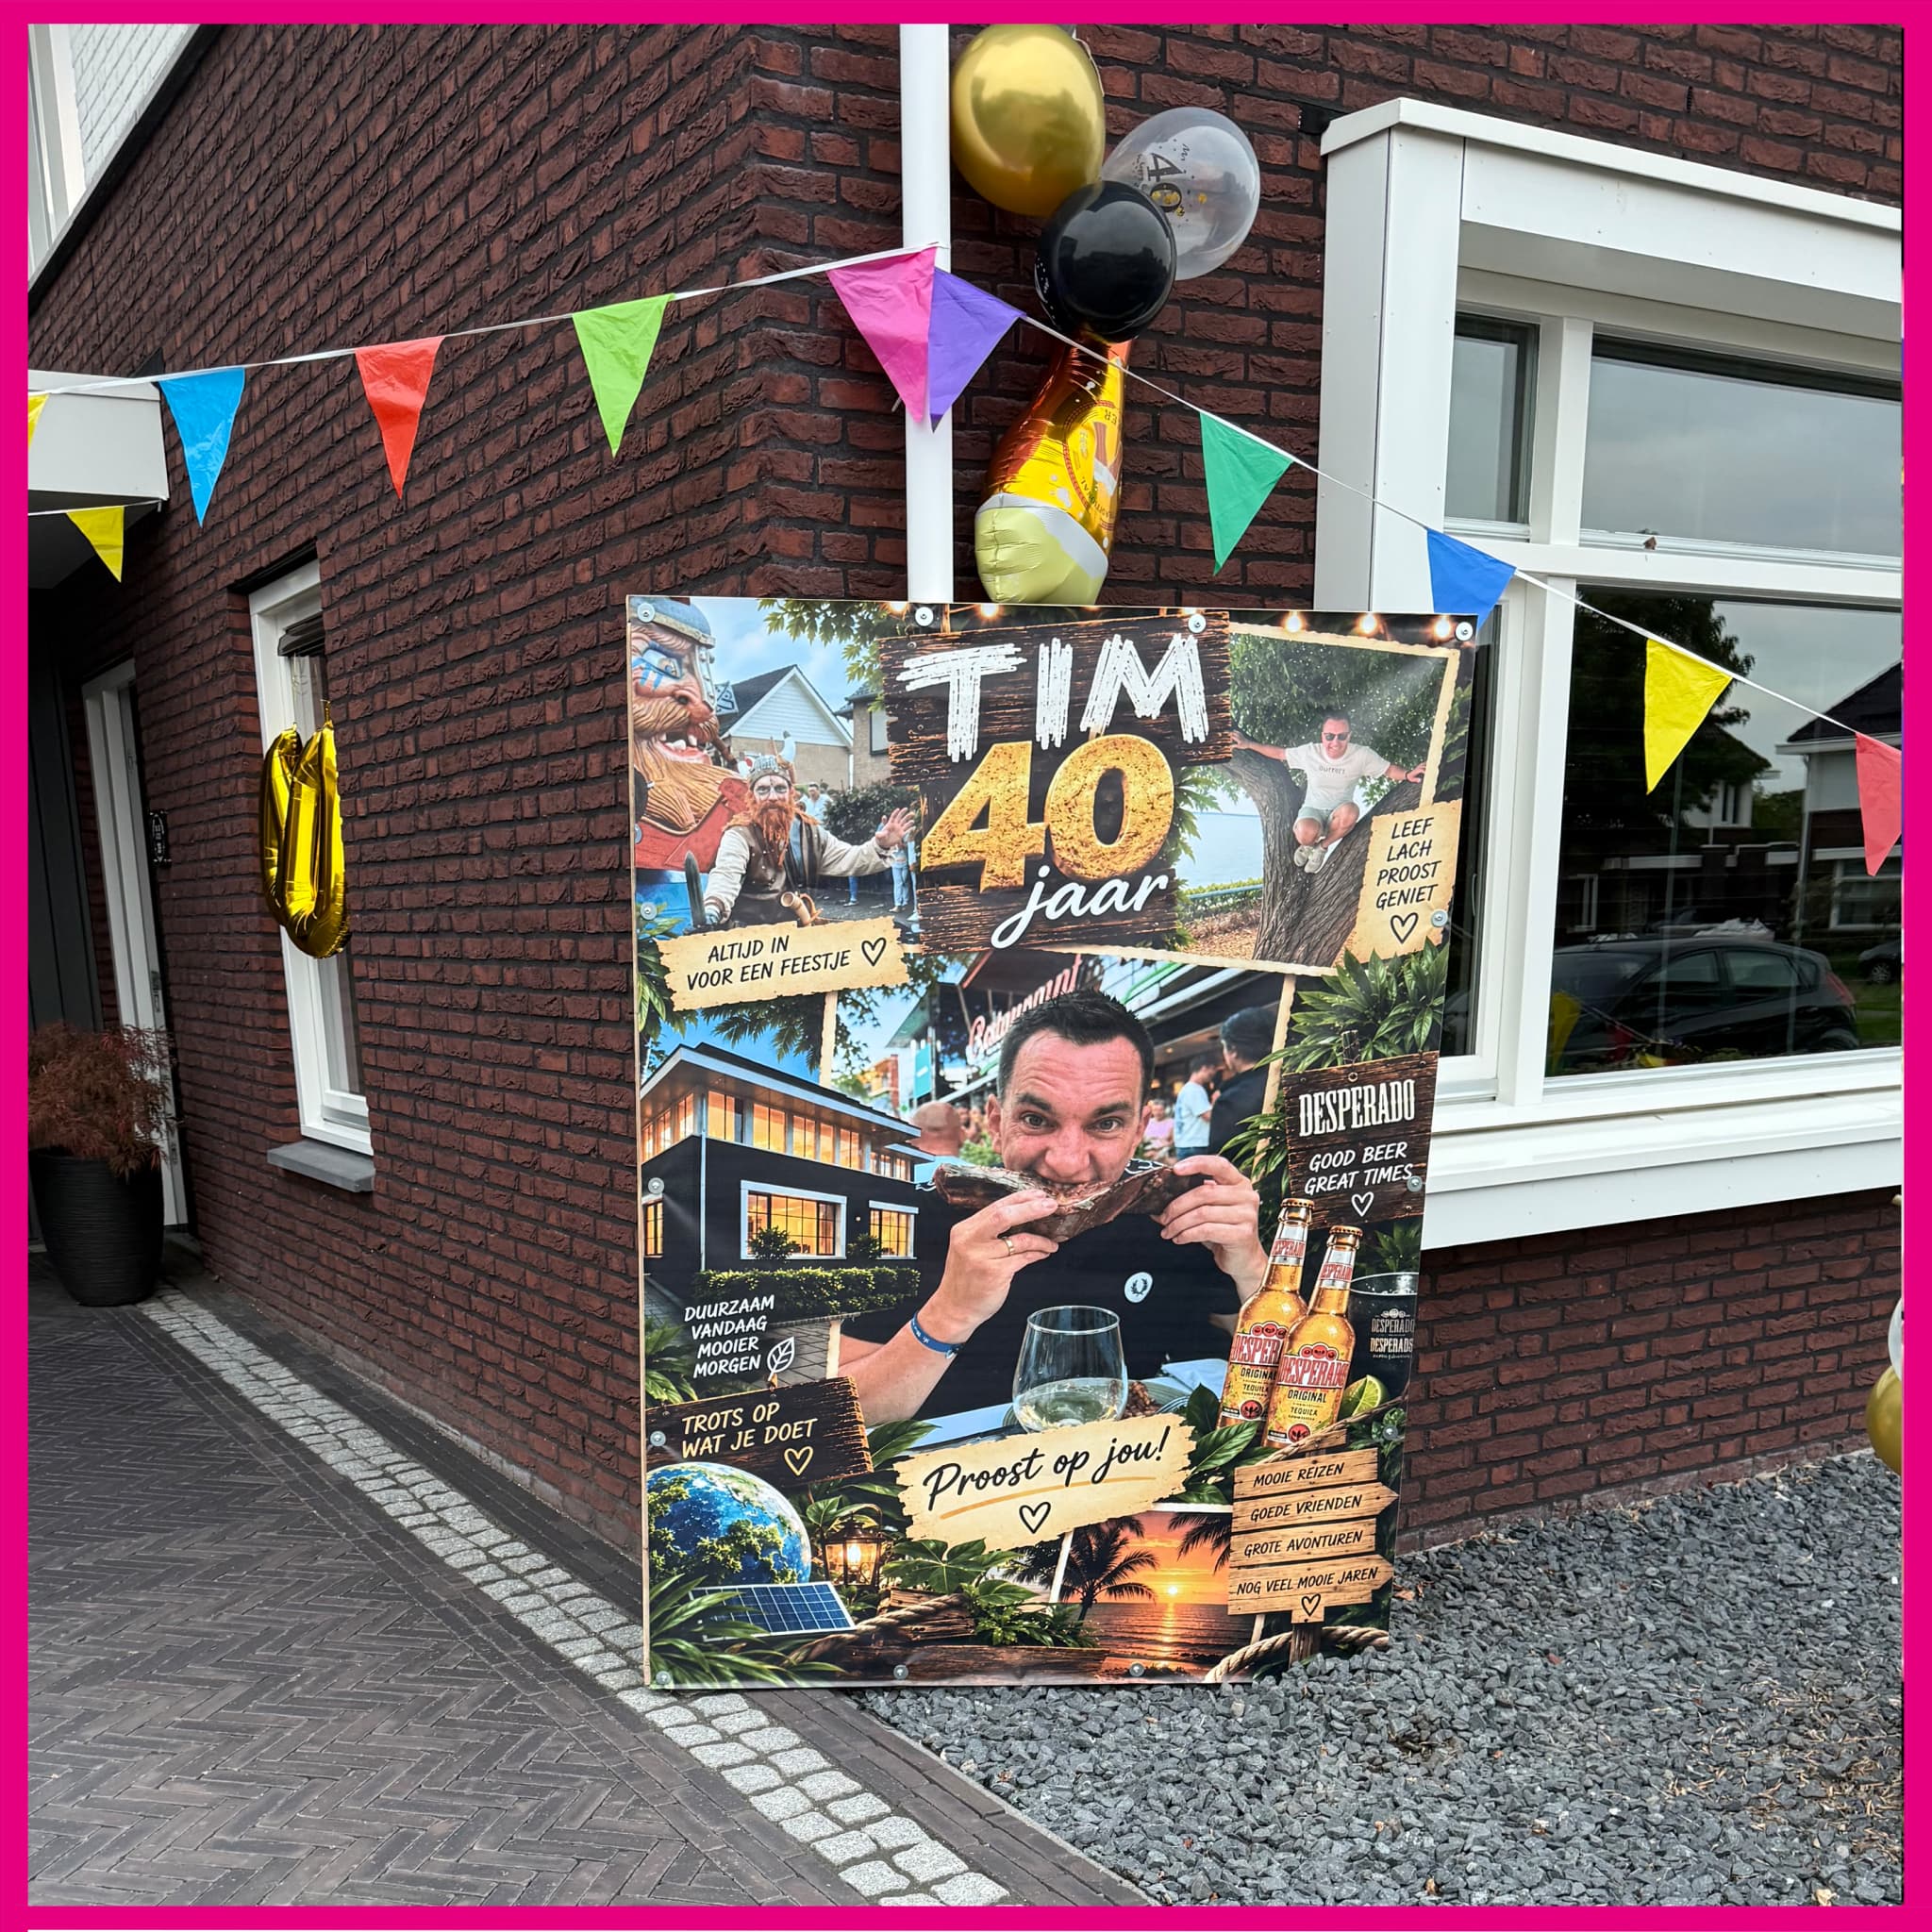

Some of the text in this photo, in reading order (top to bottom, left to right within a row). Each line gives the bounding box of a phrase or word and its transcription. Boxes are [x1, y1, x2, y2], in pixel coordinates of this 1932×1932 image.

[896, 633, 1209, 762] TIM
[920, 733, 1175, 894] 40
[1391, 817, 1434, 840] LEEF
[1386, 840, 1433, 862] LACH
[1376, 860, 1441, 887] PROOST
[991, 865, 1169, 949] jaar
[1375, 884, 1439, 910] GENIET
[708, 935, 790, 963] ALTIJD IN
[686, 950, 851, 991] VOOR EEN FEESTJE
[1298, 1078, 1416, 1137] DESPERADO
[1308, 1141, 1408, 1174] GOOD BEER
[1304, 1163, 1413, 1196] GREAT TIMES
[684, 1294, 774, 1322] DUURZAAM
[691, 1315, 768, 1340] VANDAAG
[697, 1336, 759, 1359] MOOIER
[693, 1354, 761, 1378] MORGEN
[1288, 1389, 1327, 1404] ORIGINAL
[681, 1402, 780, 1435] TROTS OP
[681, 1418, 818, 1458] WAT JE DOET
[922, 1425, 1172, 1511] Proost op jou!
[1253, 1462, 1345, 1488] MOOIE REIZEN
[1250, 1494, 1363, 1523] GOEDE VRIENDEN
[1244, 1530, 1363, 1557] GROTE AVONTUREN
[1236, 1566, 1379, 1596] NOG VEEL MOOIE JAREN
